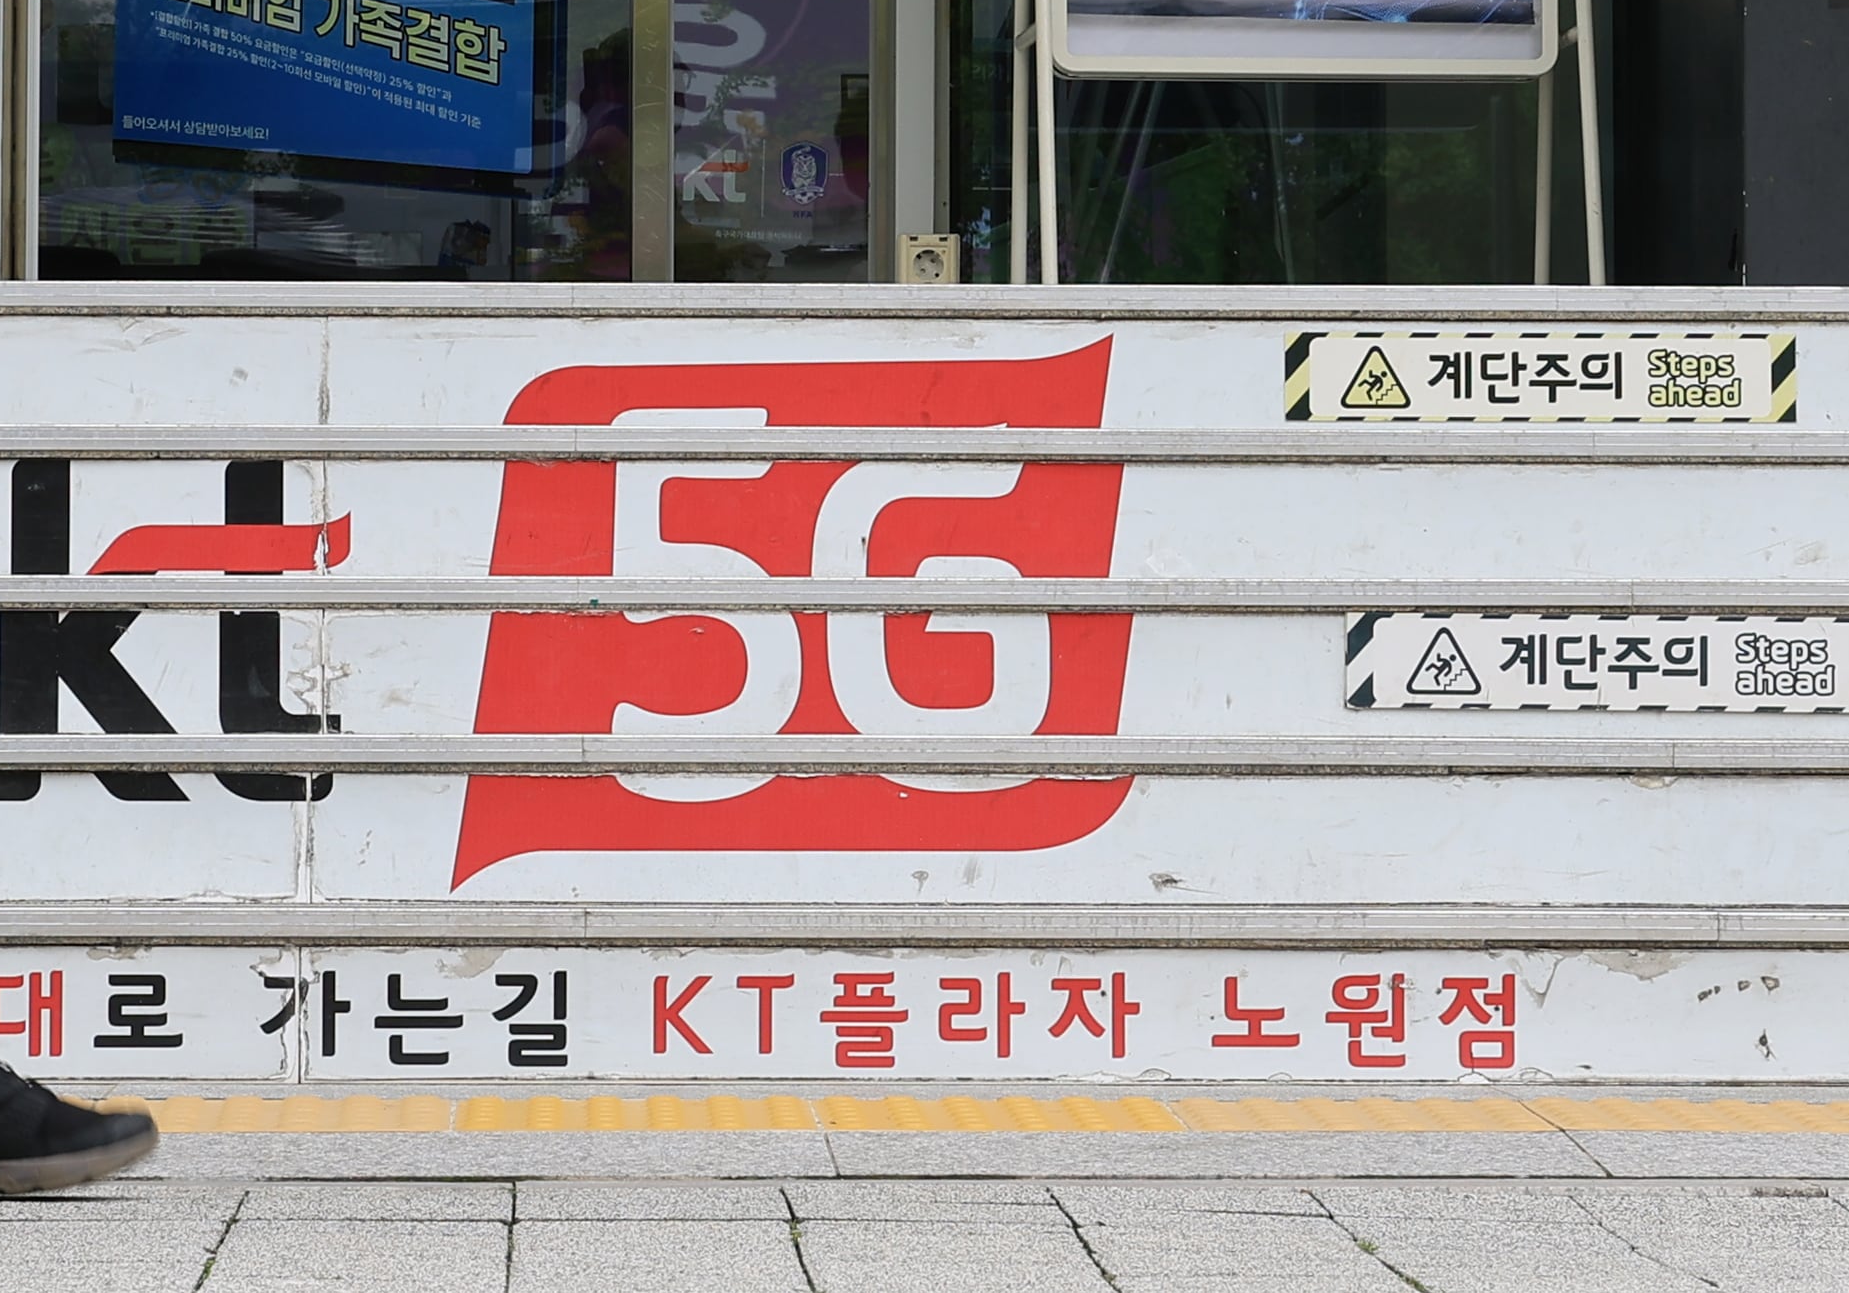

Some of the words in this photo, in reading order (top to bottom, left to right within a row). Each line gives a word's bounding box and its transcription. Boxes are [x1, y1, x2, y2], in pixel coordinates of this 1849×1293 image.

[230, 32, 253, 47] 50%
[388, 76, 415, 92] 25%
[121, 114, 182, 135] 들어오셔서
[183, 119, 270, 141] 상담받아보세요!
[682, 147, 750, 205] kt
[1427, 350, 1624, 404] 계단주의
[1647, 348, 1736, 382] Steps
[1648, 378, 1742, 408] ahead
[604, 407, 1068, 804] 5G
[1499, 633, 1710, 691] 계단주의
[1735, 633, 1829, 666] Steps
[1735, 664, 1837, 697] ahead
[260, 969, 571, 1072] 가는길
[651, 969, 1142, 1070] KT플라자
[1210, 971, 1517, 1070] 노원점
